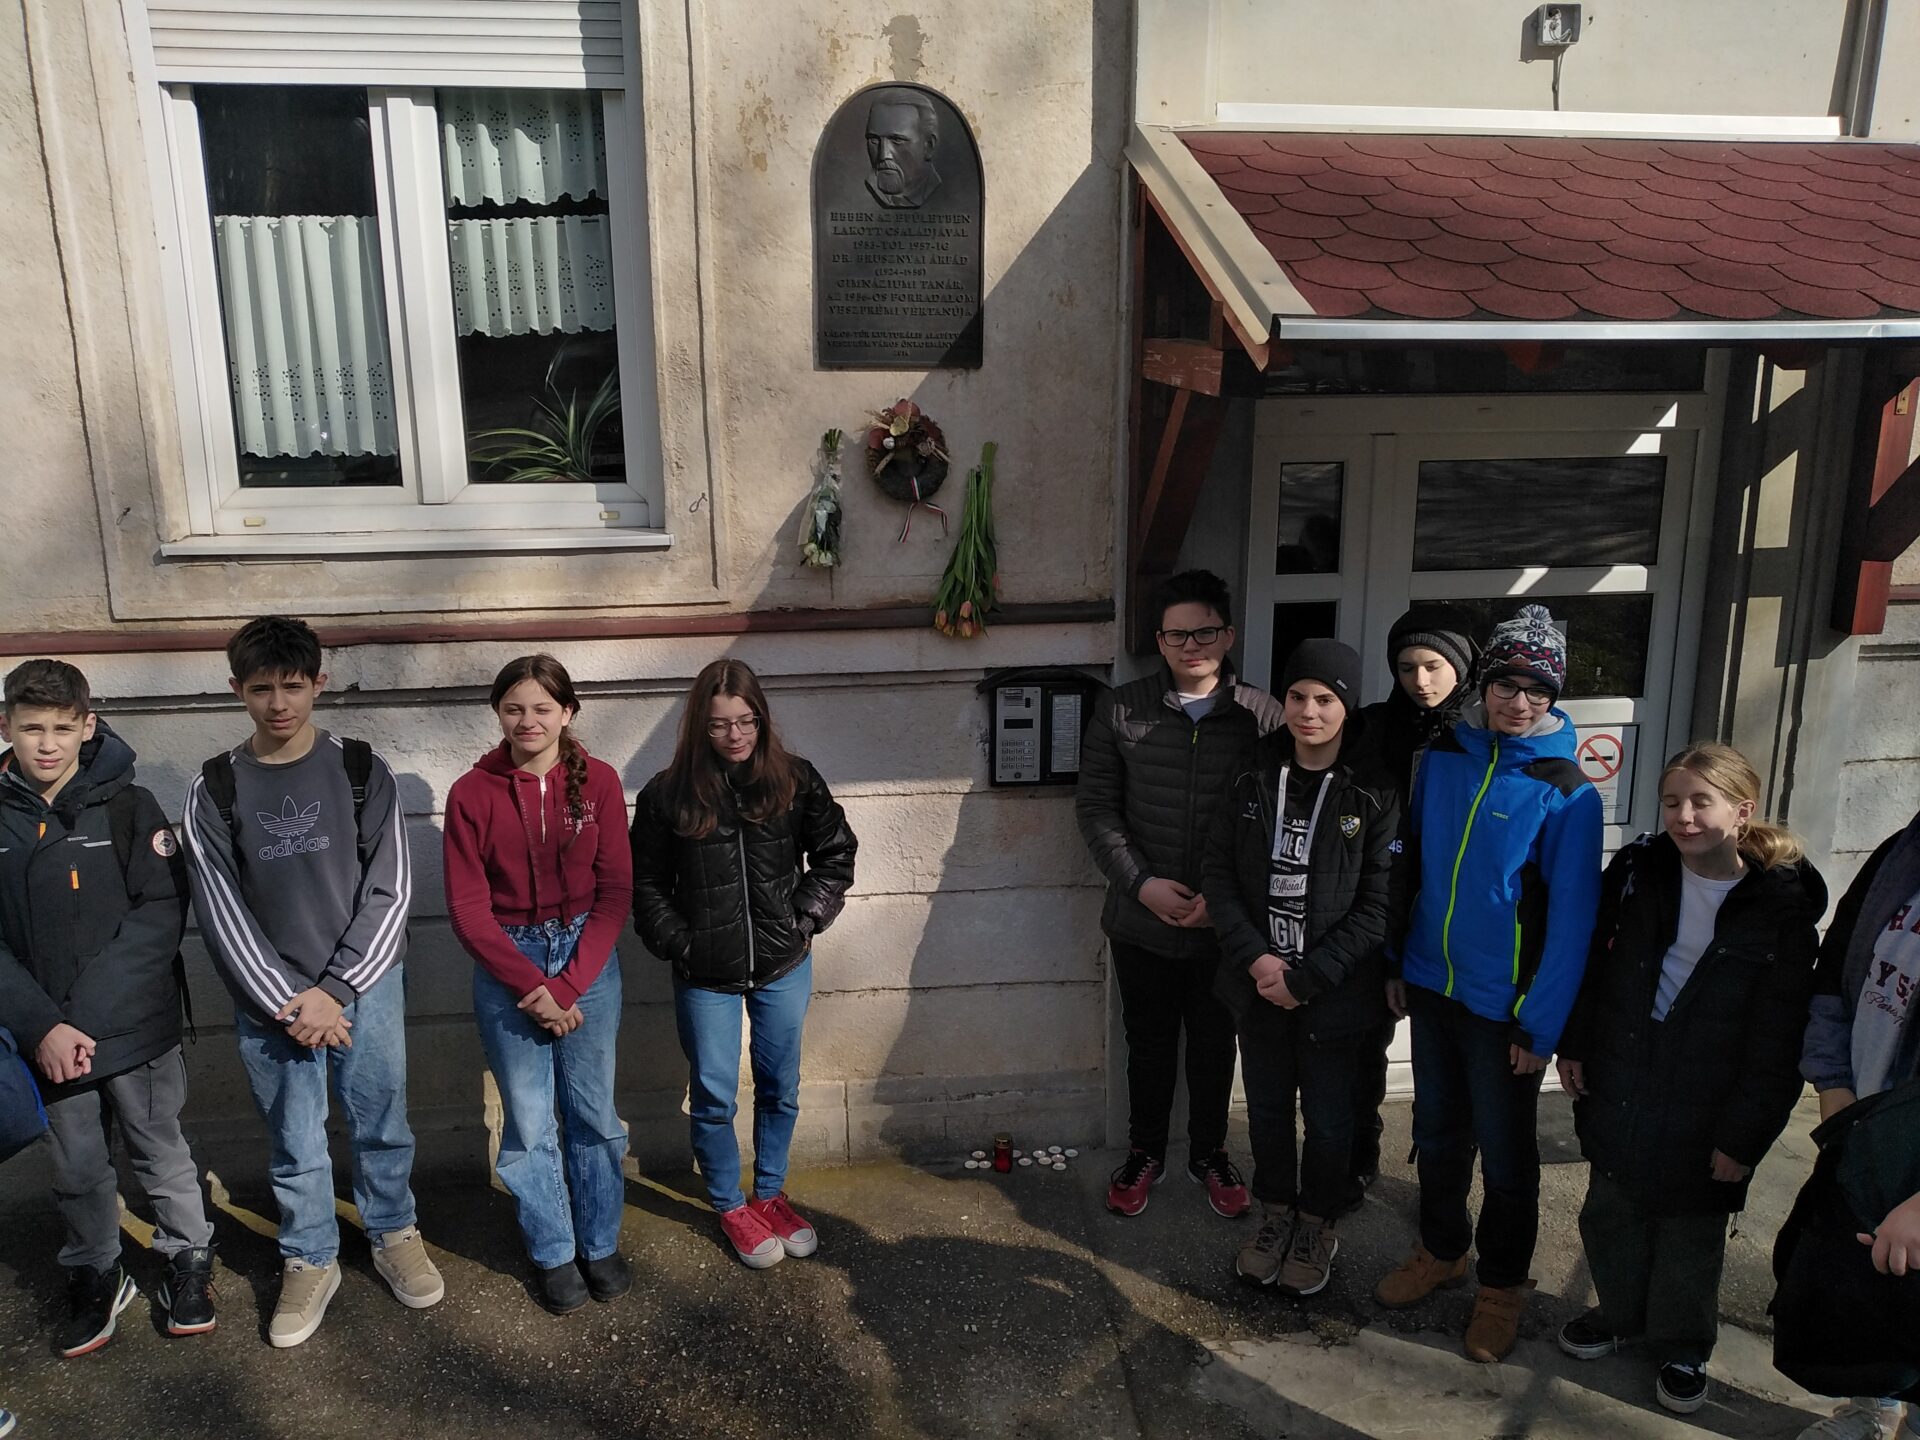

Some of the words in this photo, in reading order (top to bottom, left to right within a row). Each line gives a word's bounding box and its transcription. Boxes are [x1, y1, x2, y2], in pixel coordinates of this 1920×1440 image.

[833, 226, 882, 236] LAKOTT
[258, 834, 331, 861] adidas
[1388, 839, 1403, 854] 46
[1272, 877, 1306, 894] Official
